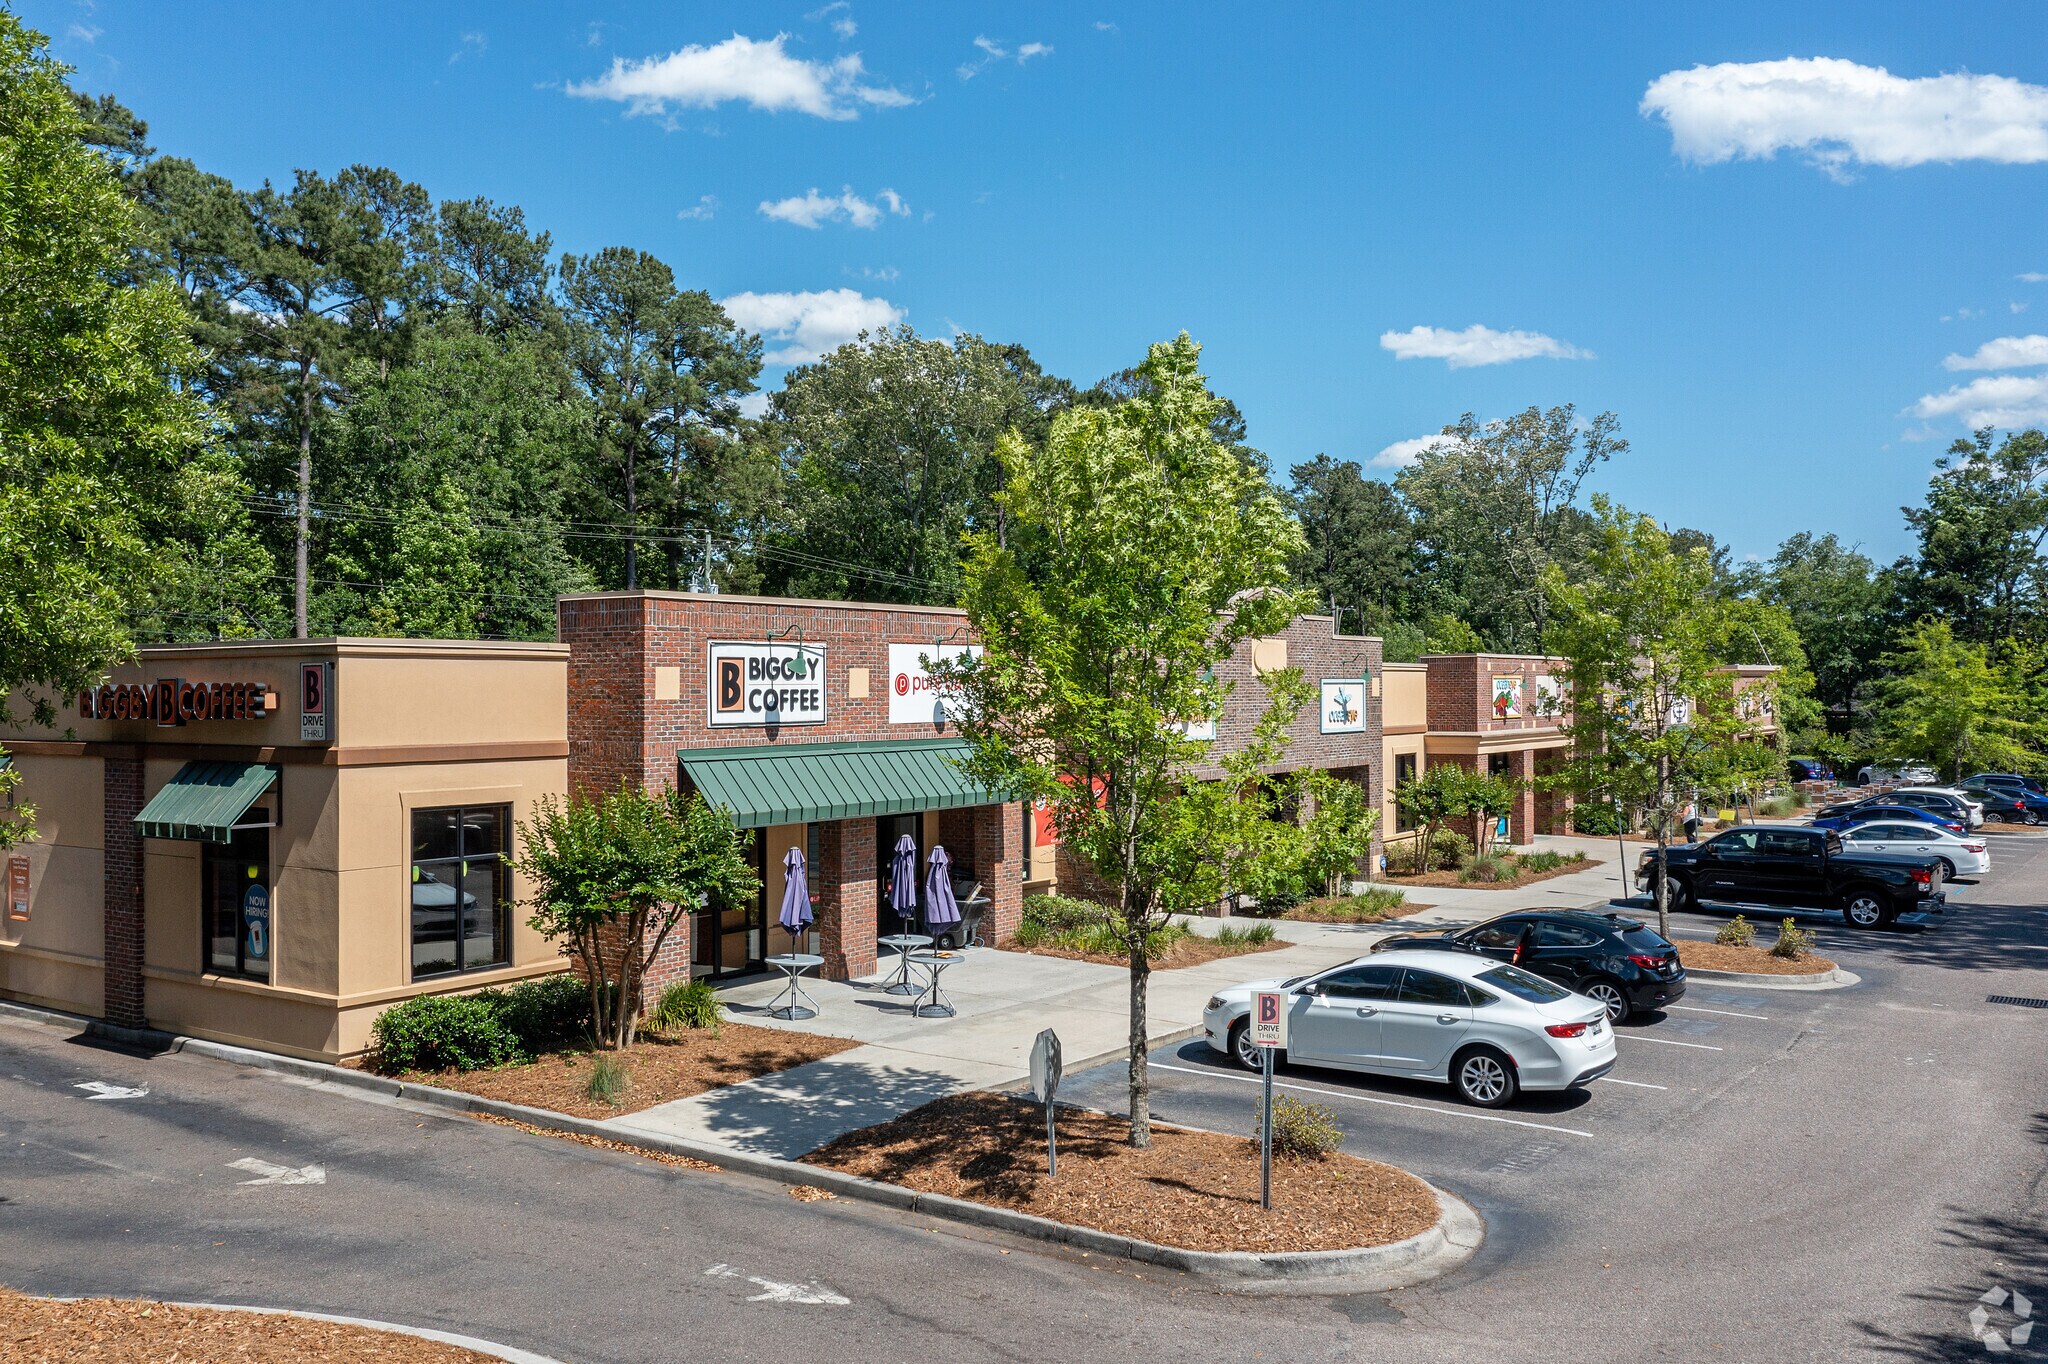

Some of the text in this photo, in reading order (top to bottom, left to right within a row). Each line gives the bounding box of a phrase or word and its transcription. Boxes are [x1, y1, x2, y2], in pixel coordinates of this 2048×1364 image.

[306, 670, 320, 710] B
[722, 662, 741, 708] B
[79, 683, 157, 720] BIGGBY
[178, 682, 260, 721] COFFEE
[748, 689, 819, 713] COFFEE
[302, 715, 324, 727] DRIVE
[303, 729, 324, 738] THRU
[249, 896, 266, 907] NOW
[1262, 997, 1276, 1021] B
